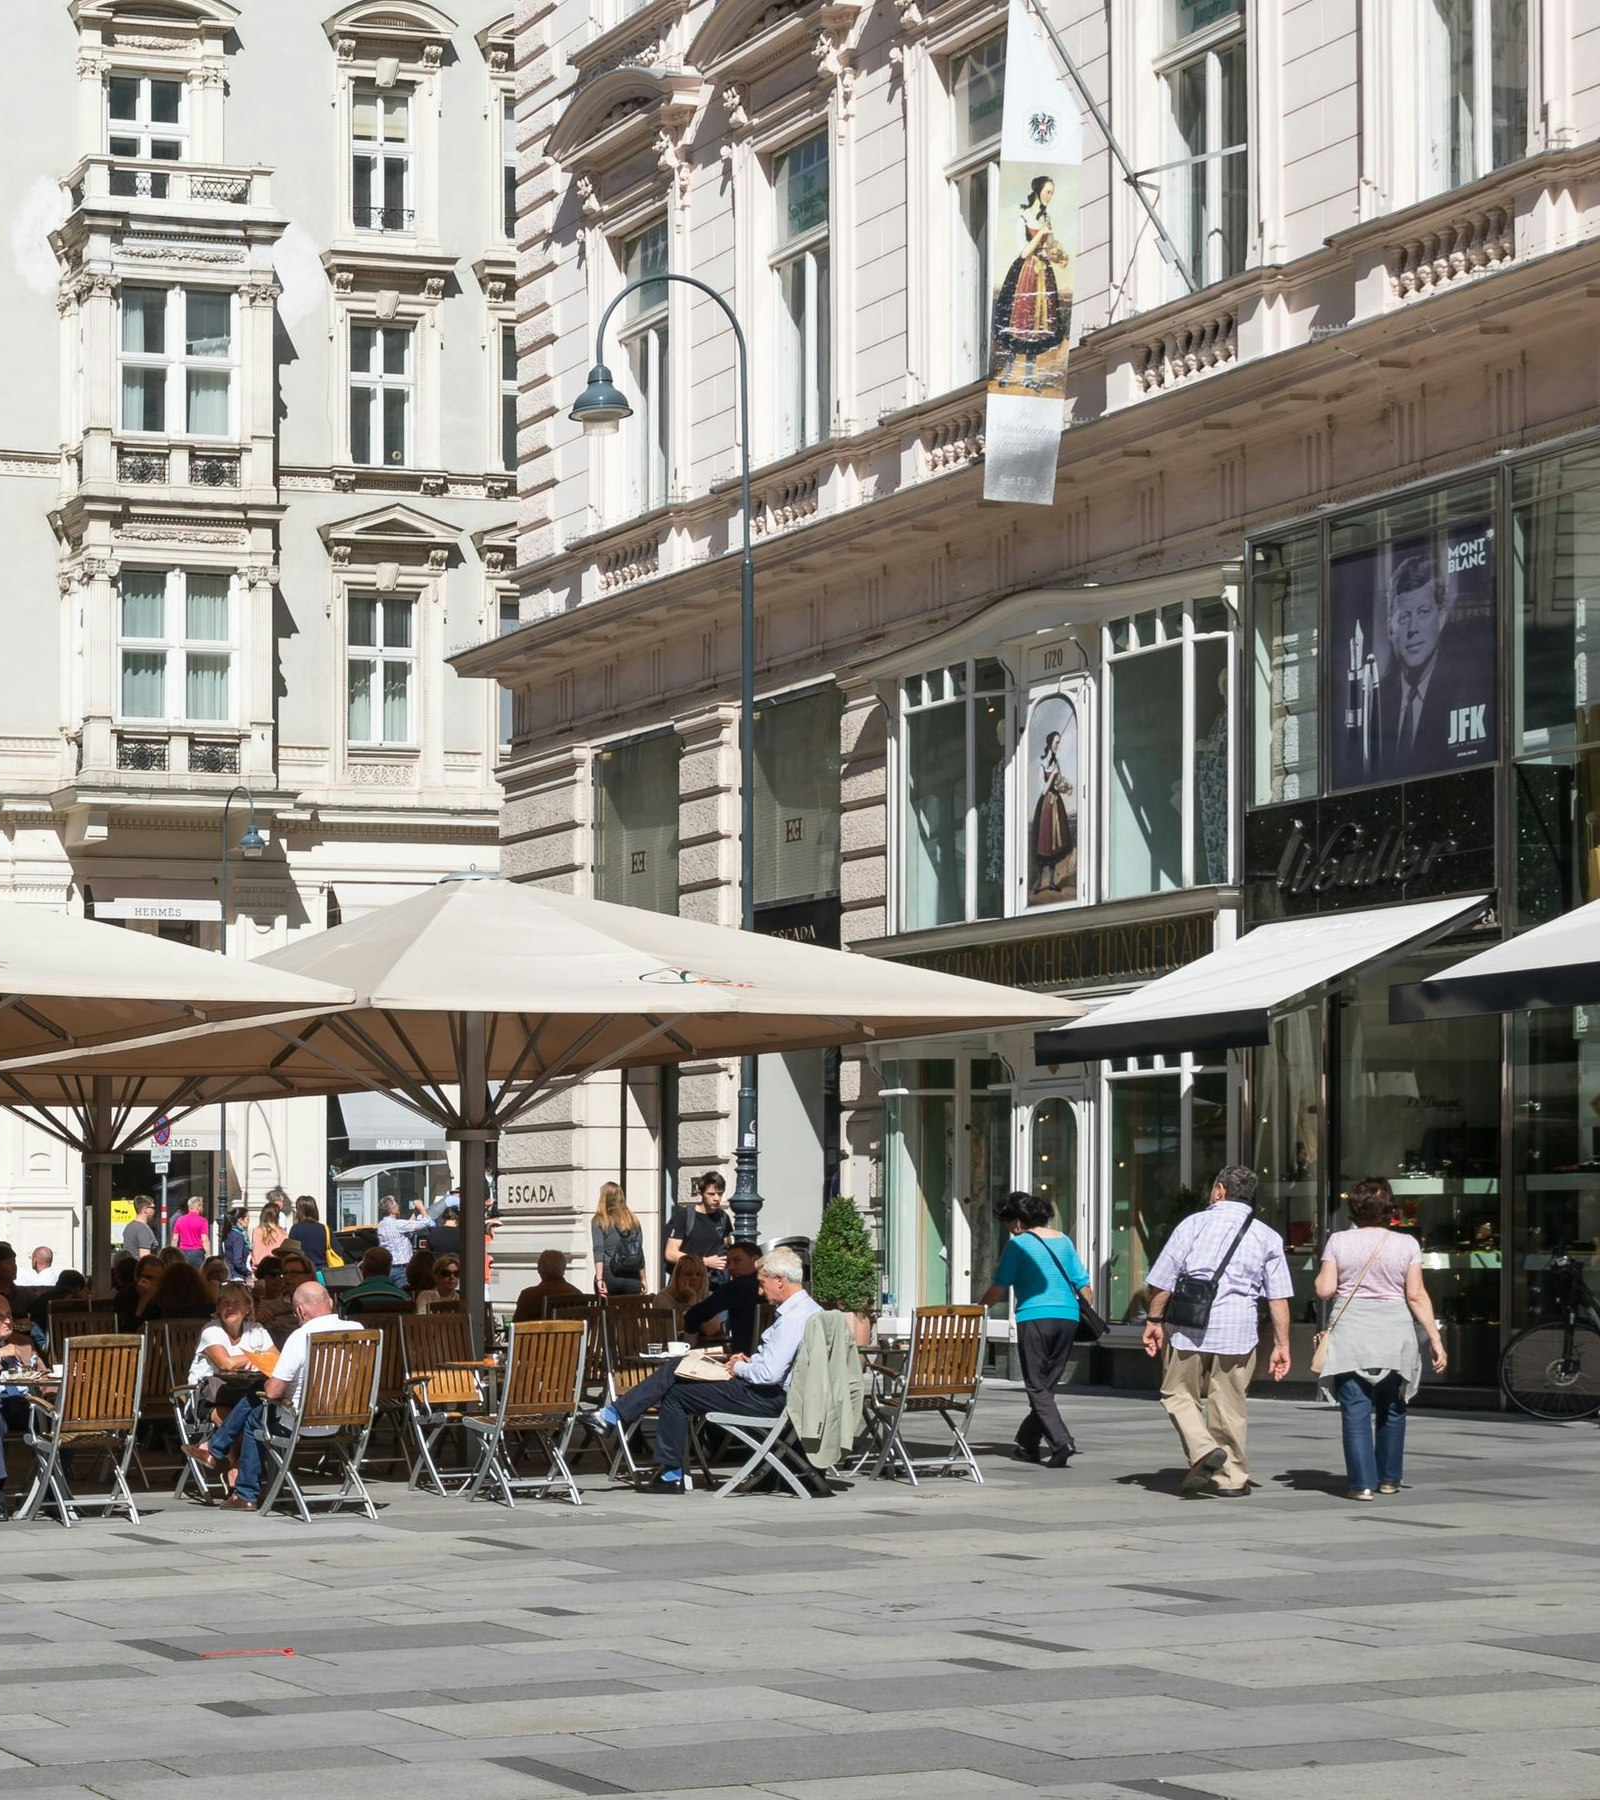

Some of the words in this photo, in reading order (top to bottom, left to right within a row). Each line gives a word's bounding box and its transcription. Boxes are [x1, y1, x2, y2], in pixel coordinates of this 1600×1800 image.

[1448, 537, 1486, 560] MONT
[1447, 551, 1486, 574] BLANC
[1044, 648, 1063, 670] 1720
[1447, 703, 1487, 745] JFK
[134, 906, 182, 918] HERMÈS
[150, 1137, 198, 1148] HRMÈS
[507, 1184, 556, 1204] ESCADA
